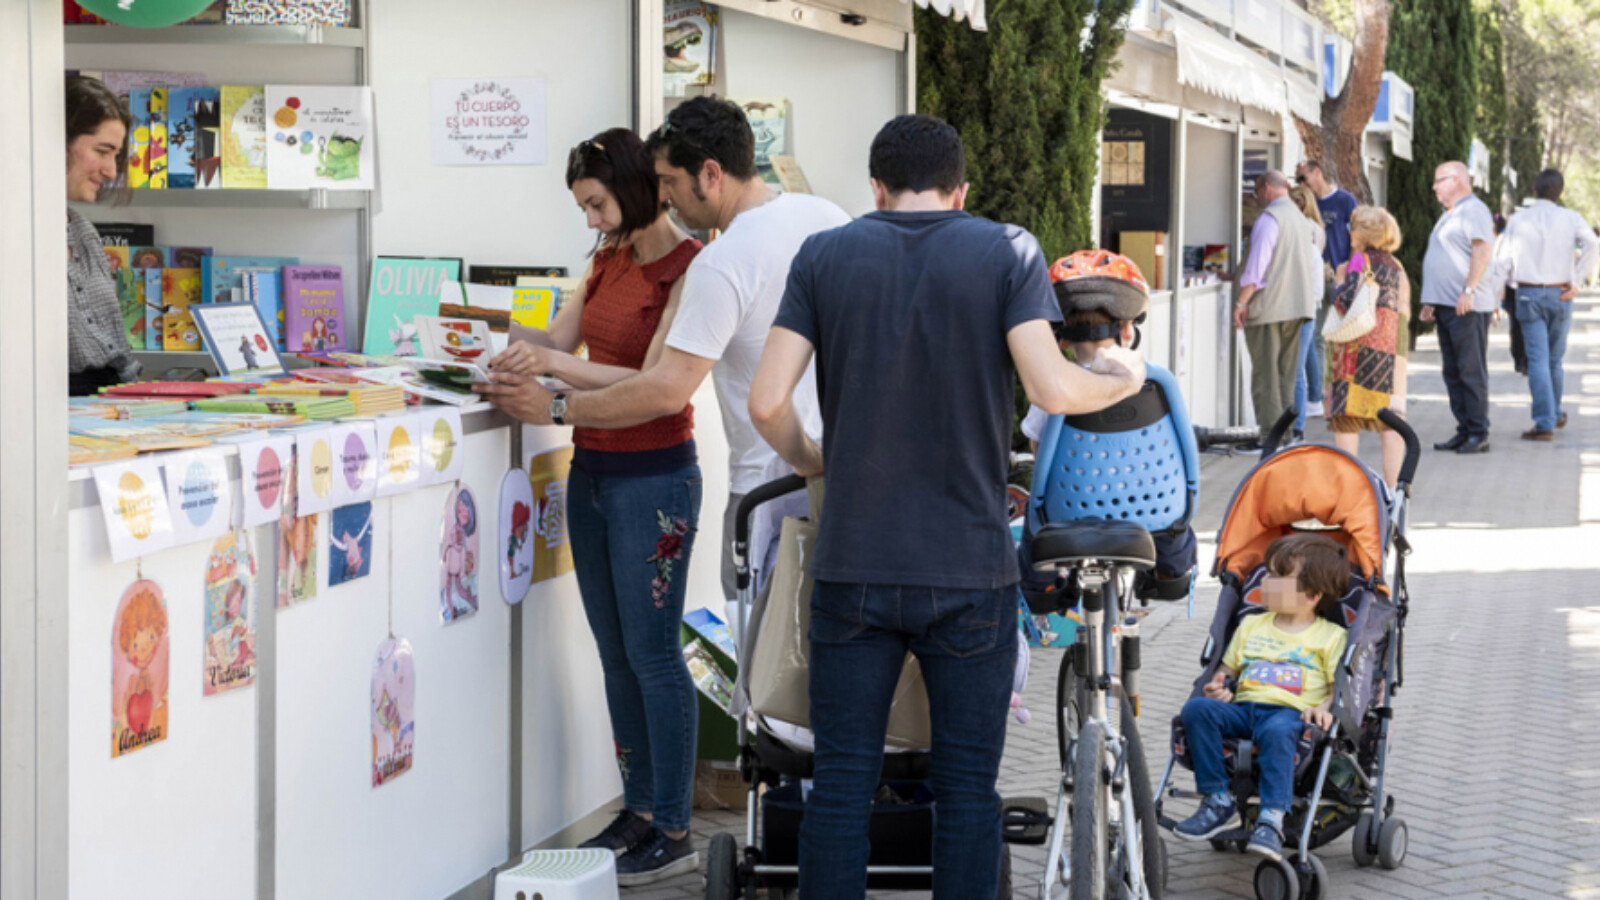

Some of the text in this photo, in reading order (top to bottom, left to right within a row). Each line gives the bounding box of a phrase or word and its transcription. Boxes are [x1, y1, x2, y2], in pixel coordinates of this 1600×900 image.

[456, 100, 521, 112] TU CUERPO
[446, 115, 530, 128] ES UN TESORO
[377, 265, 449, 297] OLIVIA
